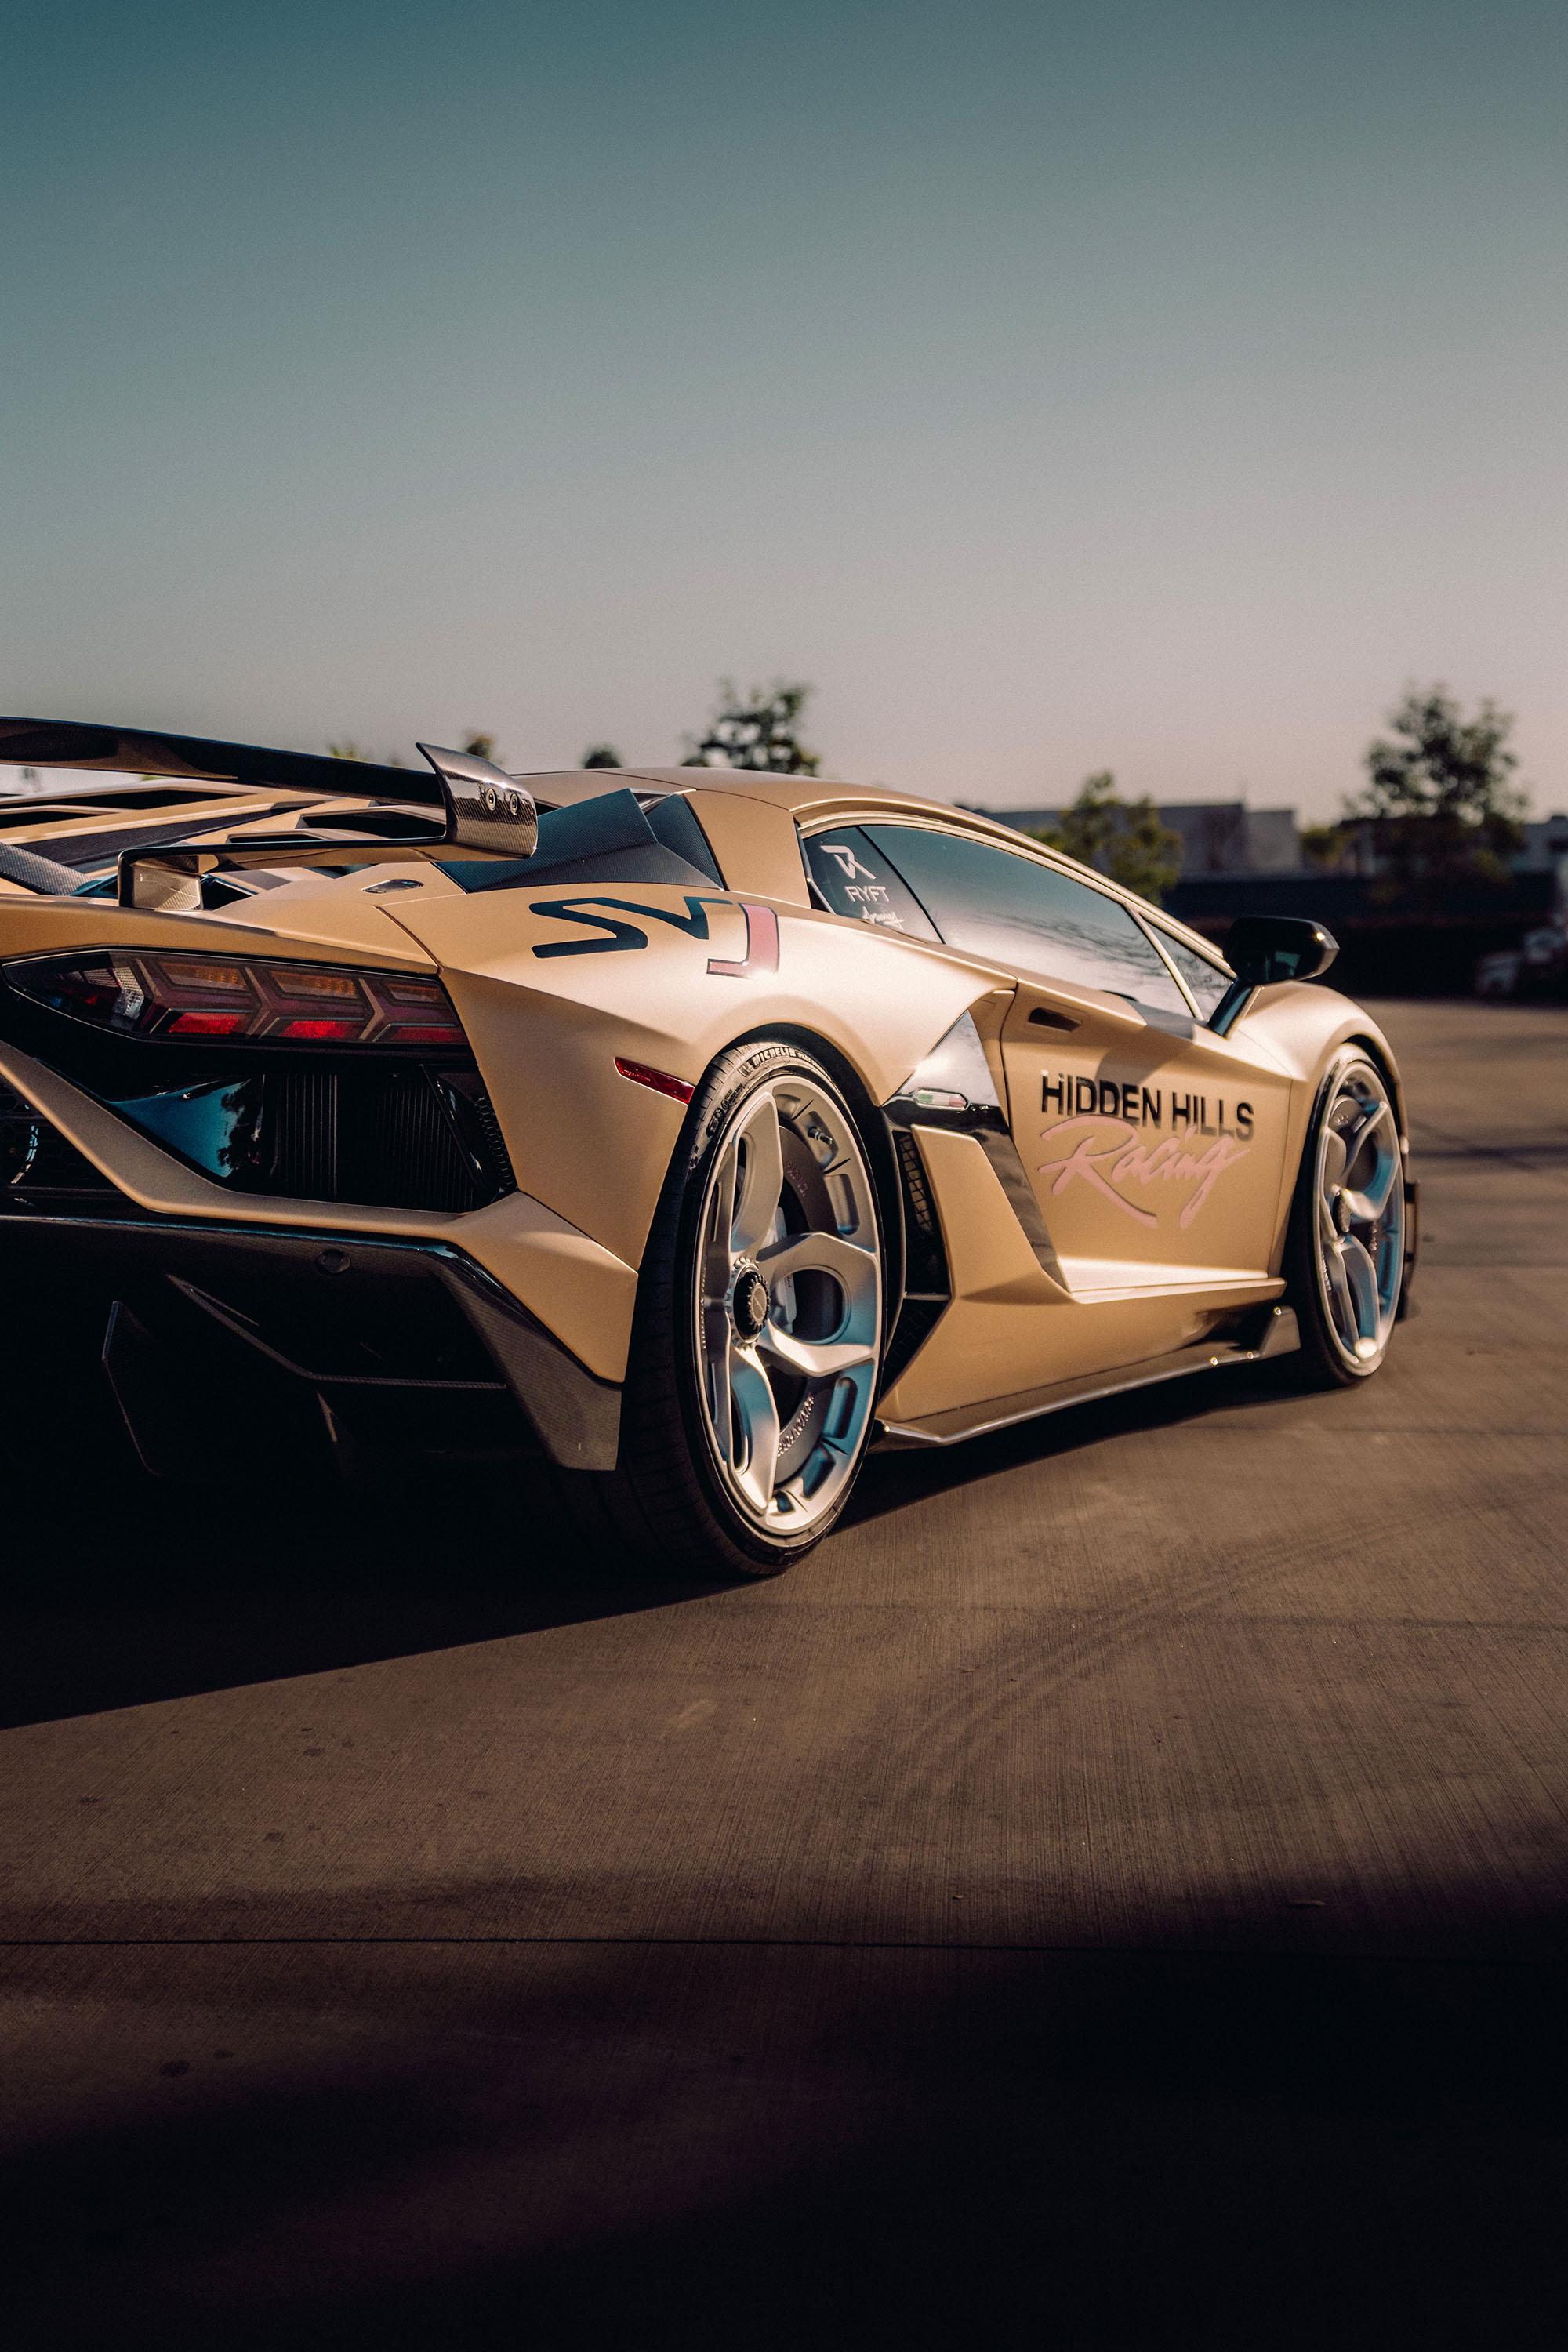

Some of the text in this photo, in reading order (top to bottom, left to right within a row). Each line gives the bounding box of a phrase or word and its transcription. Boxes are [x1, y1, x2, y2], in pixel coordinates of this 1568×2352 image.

[844, 885, 890, 902] RYFT
[528, 896, 780, 981] SVJ
[752, 1046, 797, 1068] MICHELIN
[1041, 1069, 1254, 1142] HIDDEN HILLS
[1037, 1114, 1251, 1229] Racing
